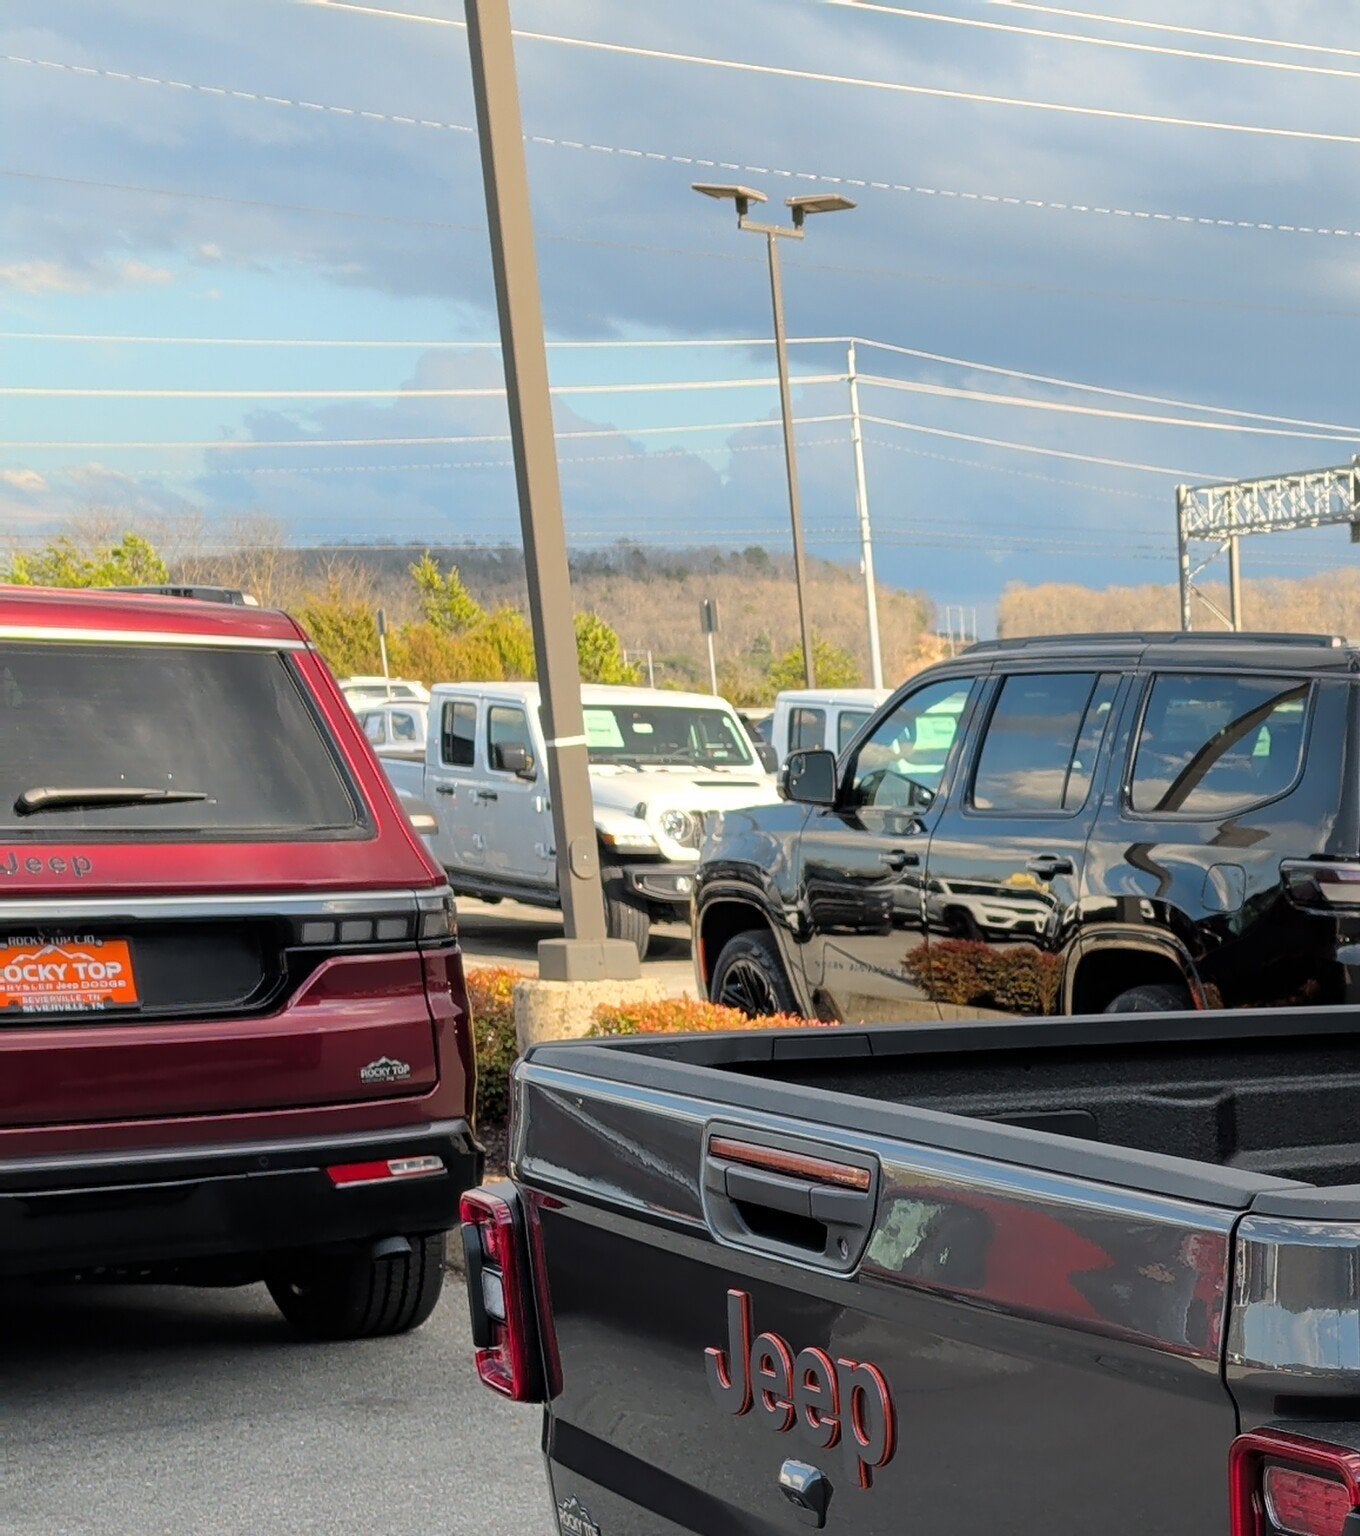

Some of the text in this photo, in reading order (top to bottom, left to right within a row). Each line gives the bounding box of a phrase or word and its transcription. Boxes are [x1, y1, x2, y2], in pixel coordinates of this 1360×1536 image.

[0, 852, 93, 878] Jeep
[8, 934, 45, 947] ROCKY
[72, 961, 122, 980] TOP
[0, 980, 126, 992] HRYSLER Jeep DODGE
[361, 1063, 411, 1079] ROCKY TOP
[704, 1288, 896, 1490] Jeep
[559, 1507, 582, 1534] ROCKY
